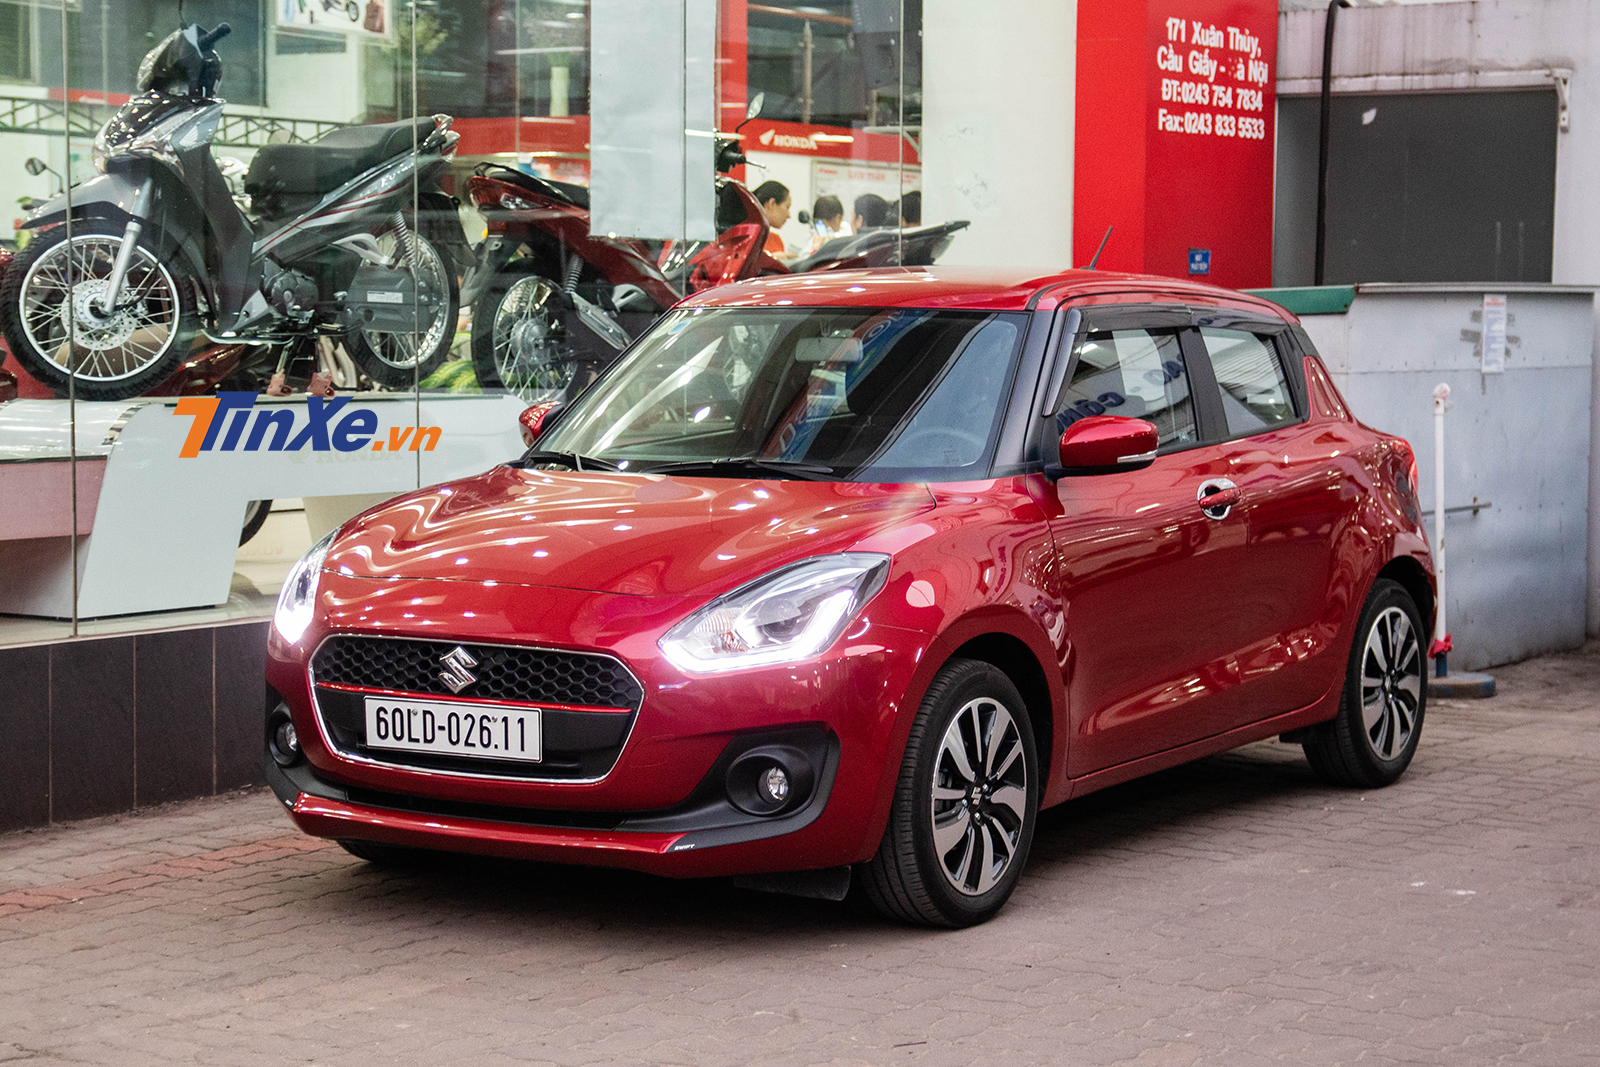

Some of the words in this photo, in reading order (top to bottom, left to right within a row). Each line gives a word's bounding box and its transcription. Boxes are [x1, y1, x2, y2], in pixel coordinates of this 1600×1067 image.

[1166, 17, 1186, 43] 171
[1191, 21, 1224, 49] Xuân
[1157, 43, 1183, 73] Cầu
[1188, 48, 1218, 83] Giấy
[1248, 59, 1269, 88] Nội
[1212, 85, 1233, 108] 754
[1236, 88, 1264, 112] 7834
[1214, 114, 1237, 137] 833
[1237, 117, 1266, 140] 5533
[375, 706, 526, 752] 60LD-026.11
